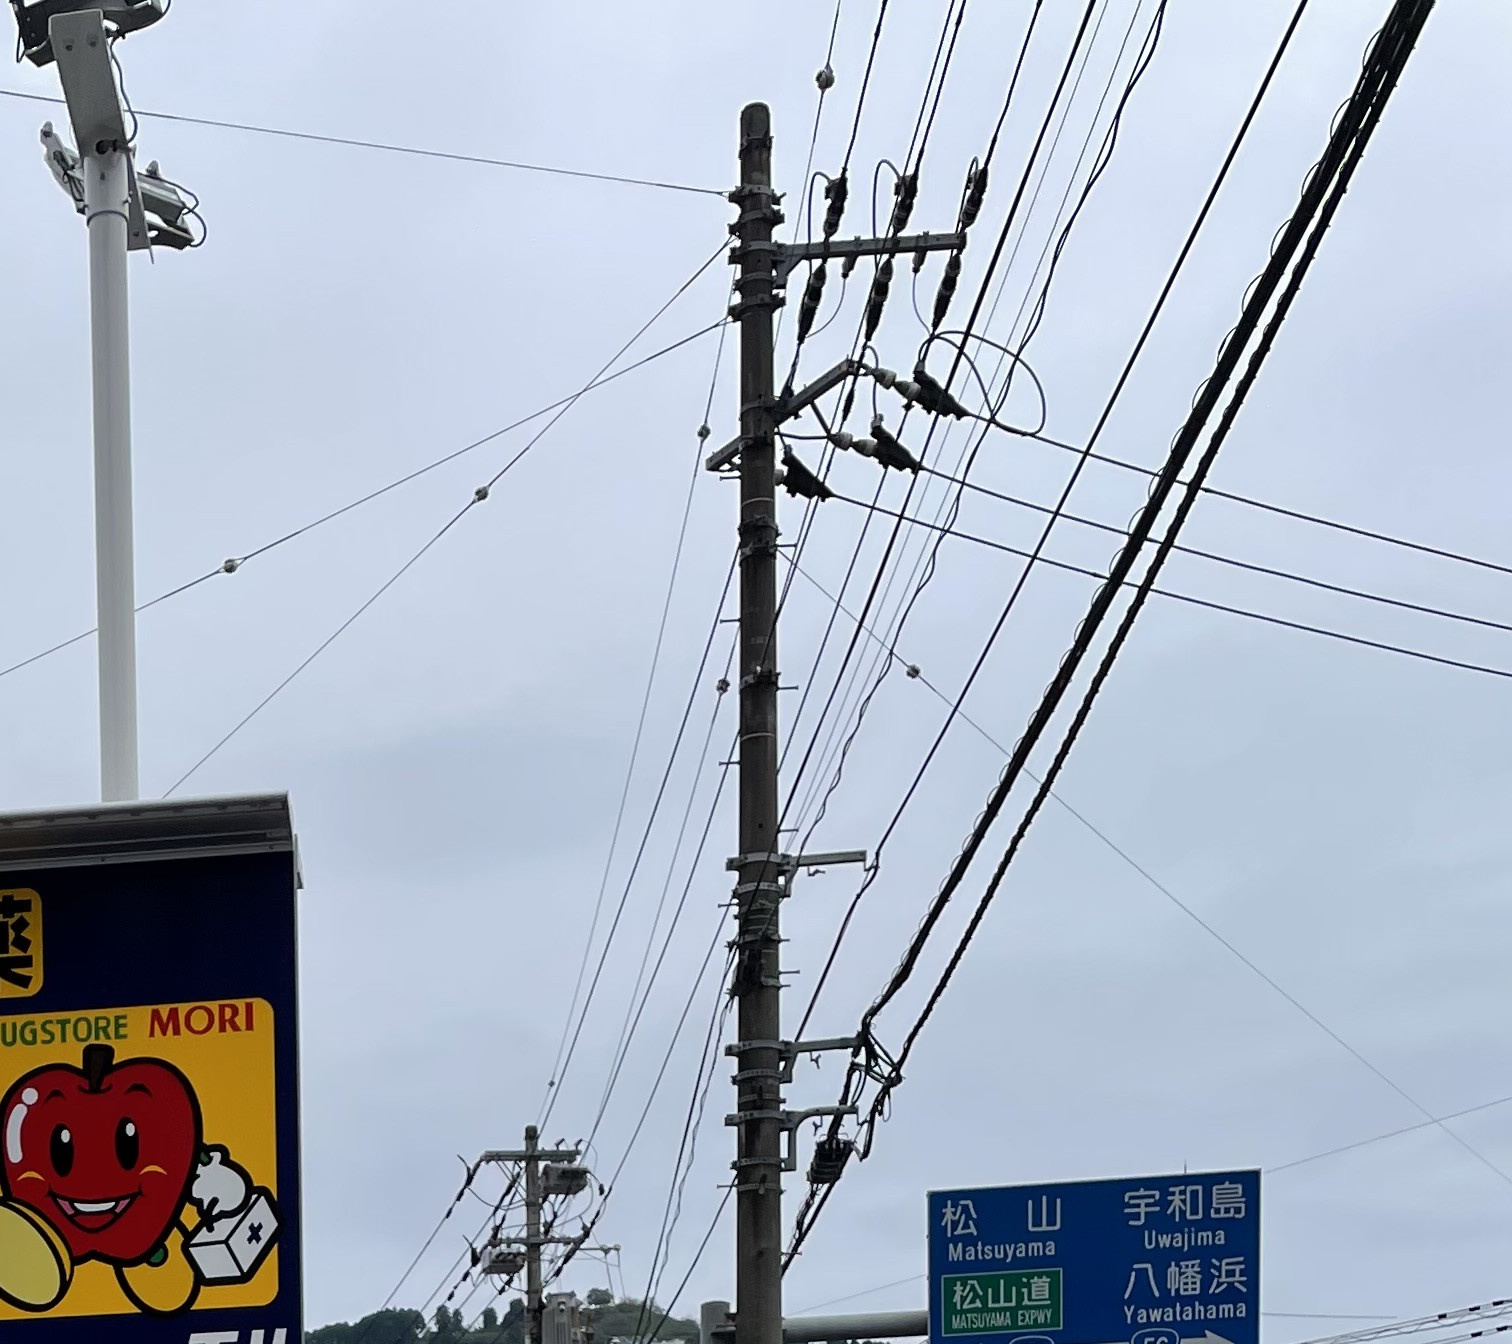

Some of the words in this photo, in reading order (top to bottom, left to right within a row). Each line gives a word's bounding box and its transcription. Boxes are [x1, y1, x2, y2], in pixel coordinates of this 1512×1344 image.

[148, 1001, 256, 1039] MORI
[941, 1195, 1062, 1238] 松山
[1124, 1181, 1247, 1226] 宇和島
[948, 1239, 1056, 1263] Matsuyama
[1144, 1227, 1226, 1252] Uwajima
[952, 1275, 1052, 1311] 松山道
[1124, 1256, 1248, 1300] 八幡浜
[951, 1311, 1012, 1330] MATSUYAMA
[1017, 1308, 1053, 1327] EXPWY
[1124, 1301, 1247, 1325] Yawatahama
